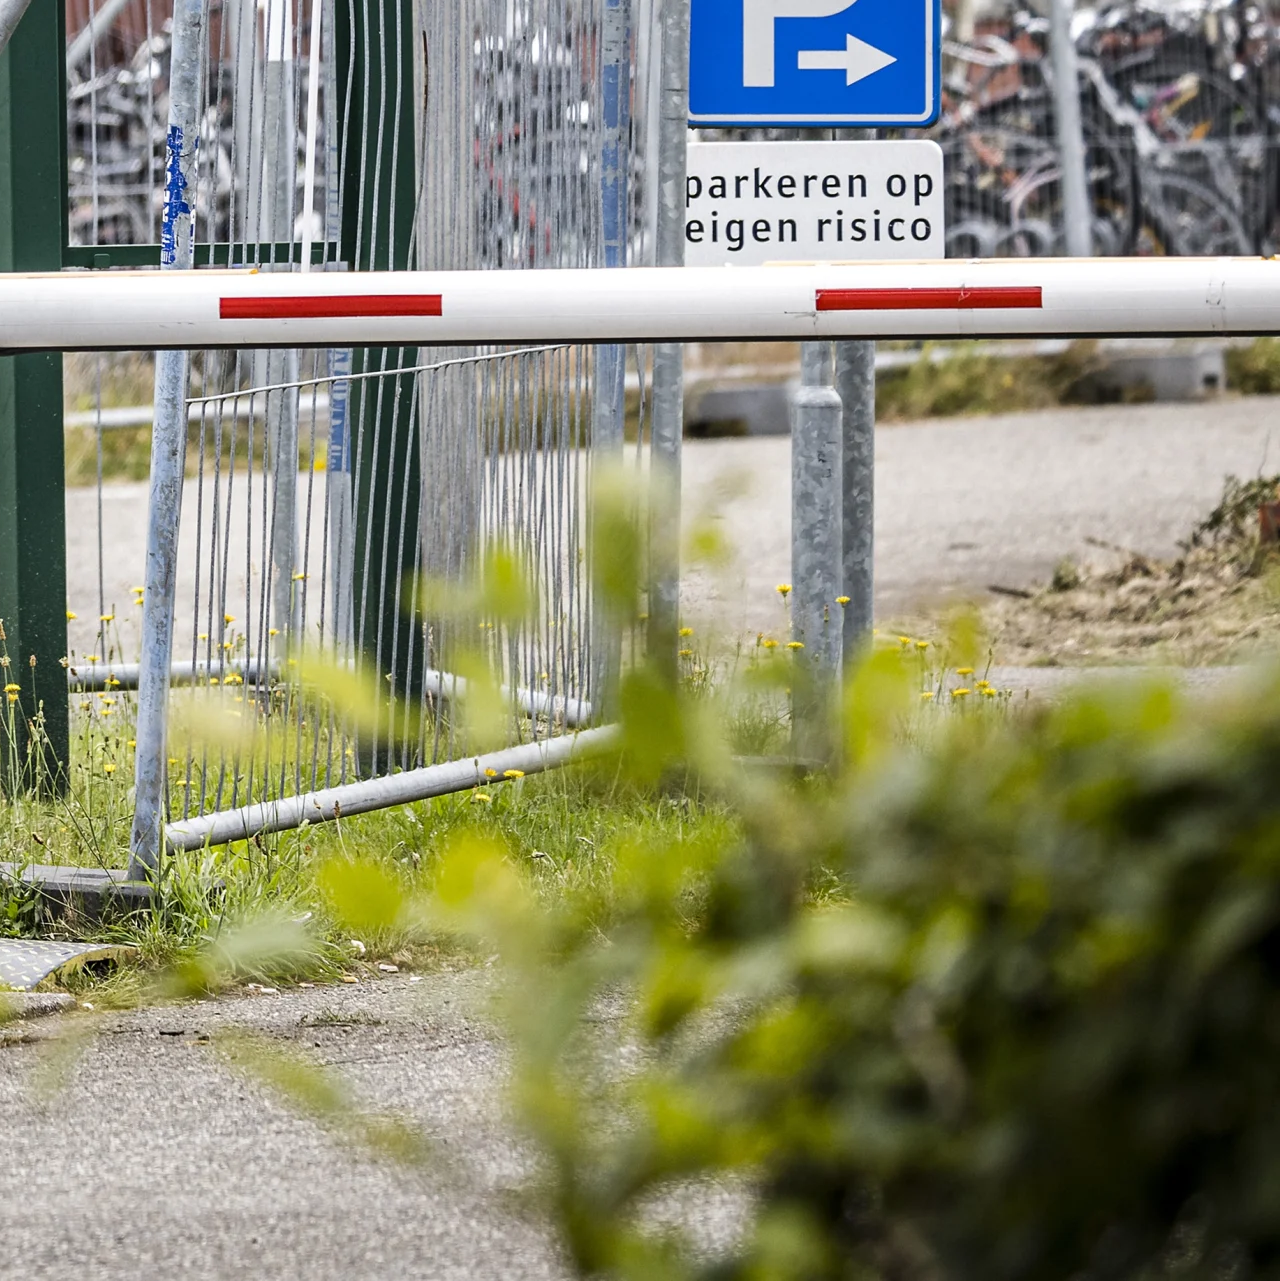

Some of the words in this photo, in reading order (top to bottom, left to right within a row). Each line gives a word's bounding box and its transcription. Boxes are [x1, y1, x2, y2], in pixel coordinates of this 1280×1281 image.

[686, 167, 868, 208] parkeren
[886, 172, 934, 208] op
[685, 210, 798, 252] eigen
[816, 209, 933, 243] risico
